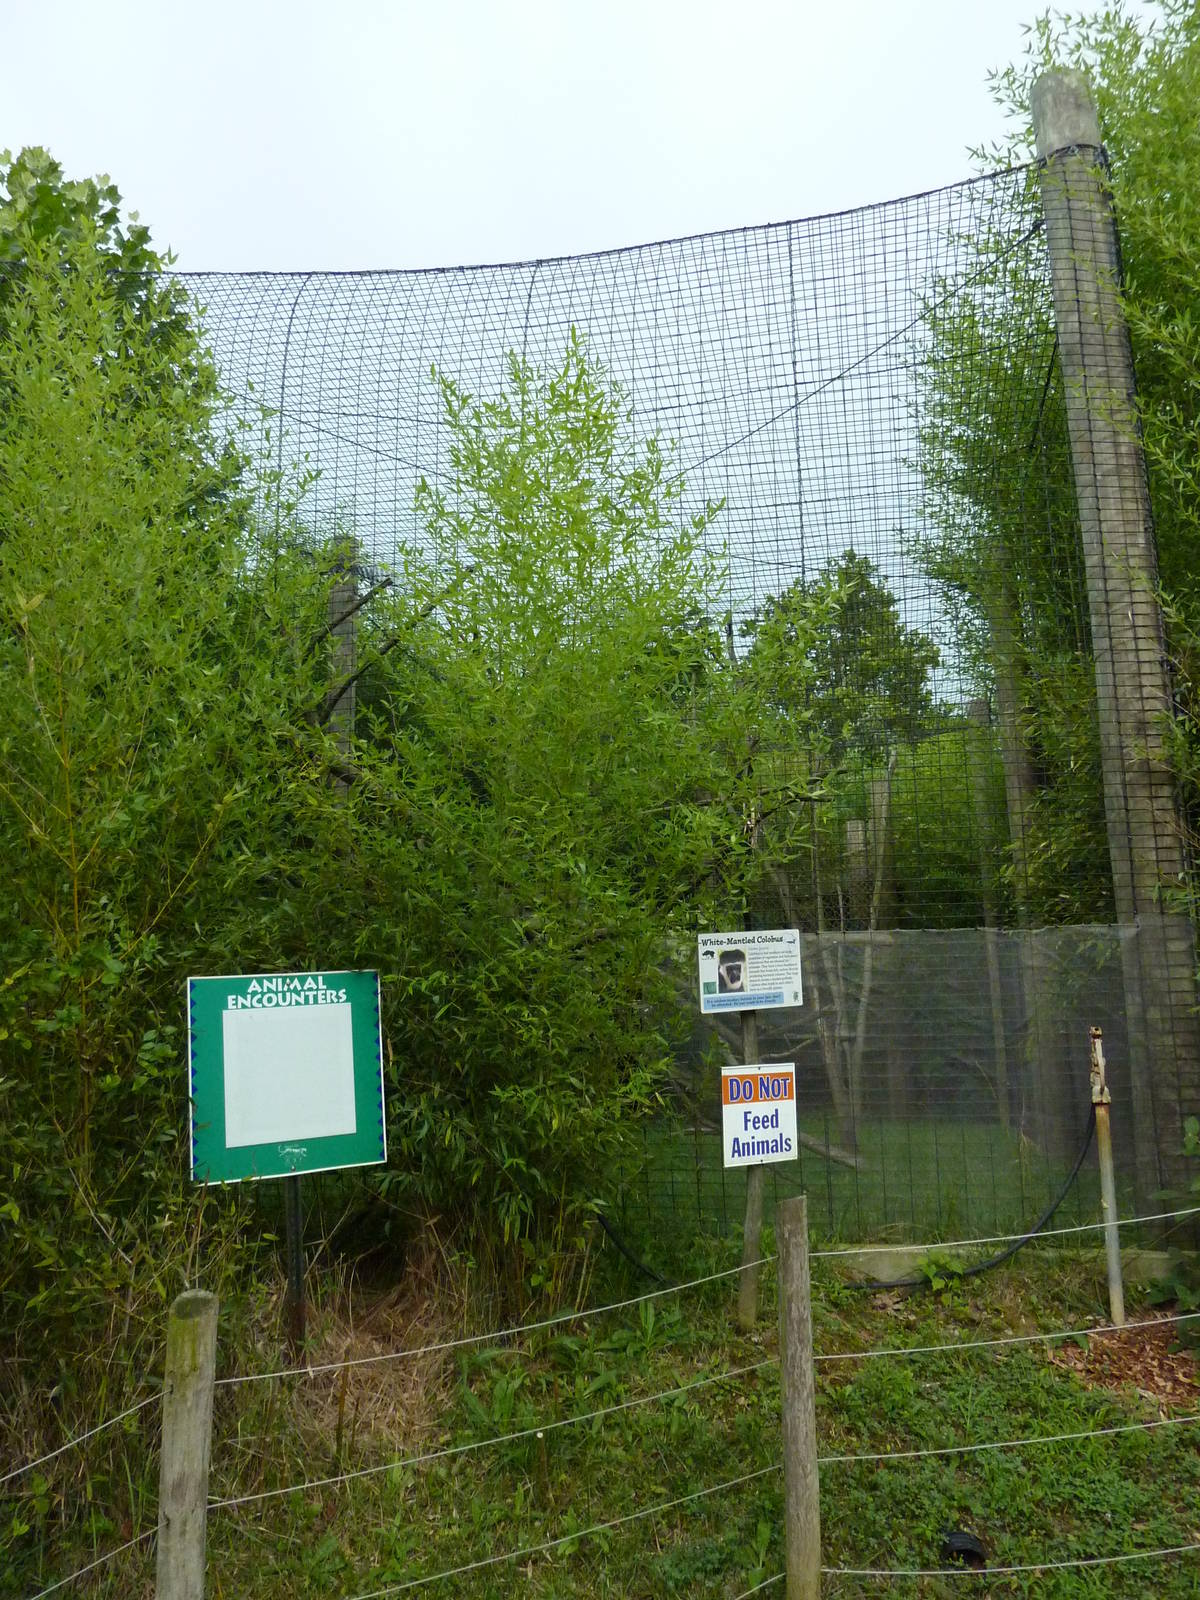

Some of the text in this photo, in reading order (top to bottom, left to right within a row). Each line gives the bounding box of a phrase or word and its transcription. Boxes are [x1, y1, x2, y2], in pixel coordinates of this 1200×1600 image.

[701, 936, 784, 946] White-Mantled Colobus
[247, 976, 327, 993] ANIMAL
[227, 989, 347, 1009] ENCOUNTERS
[759, 1076, 790, 1099] NOT
[743, 1108, 779, 1131] Feed
[731, 1132, 792, 1158] Animals
